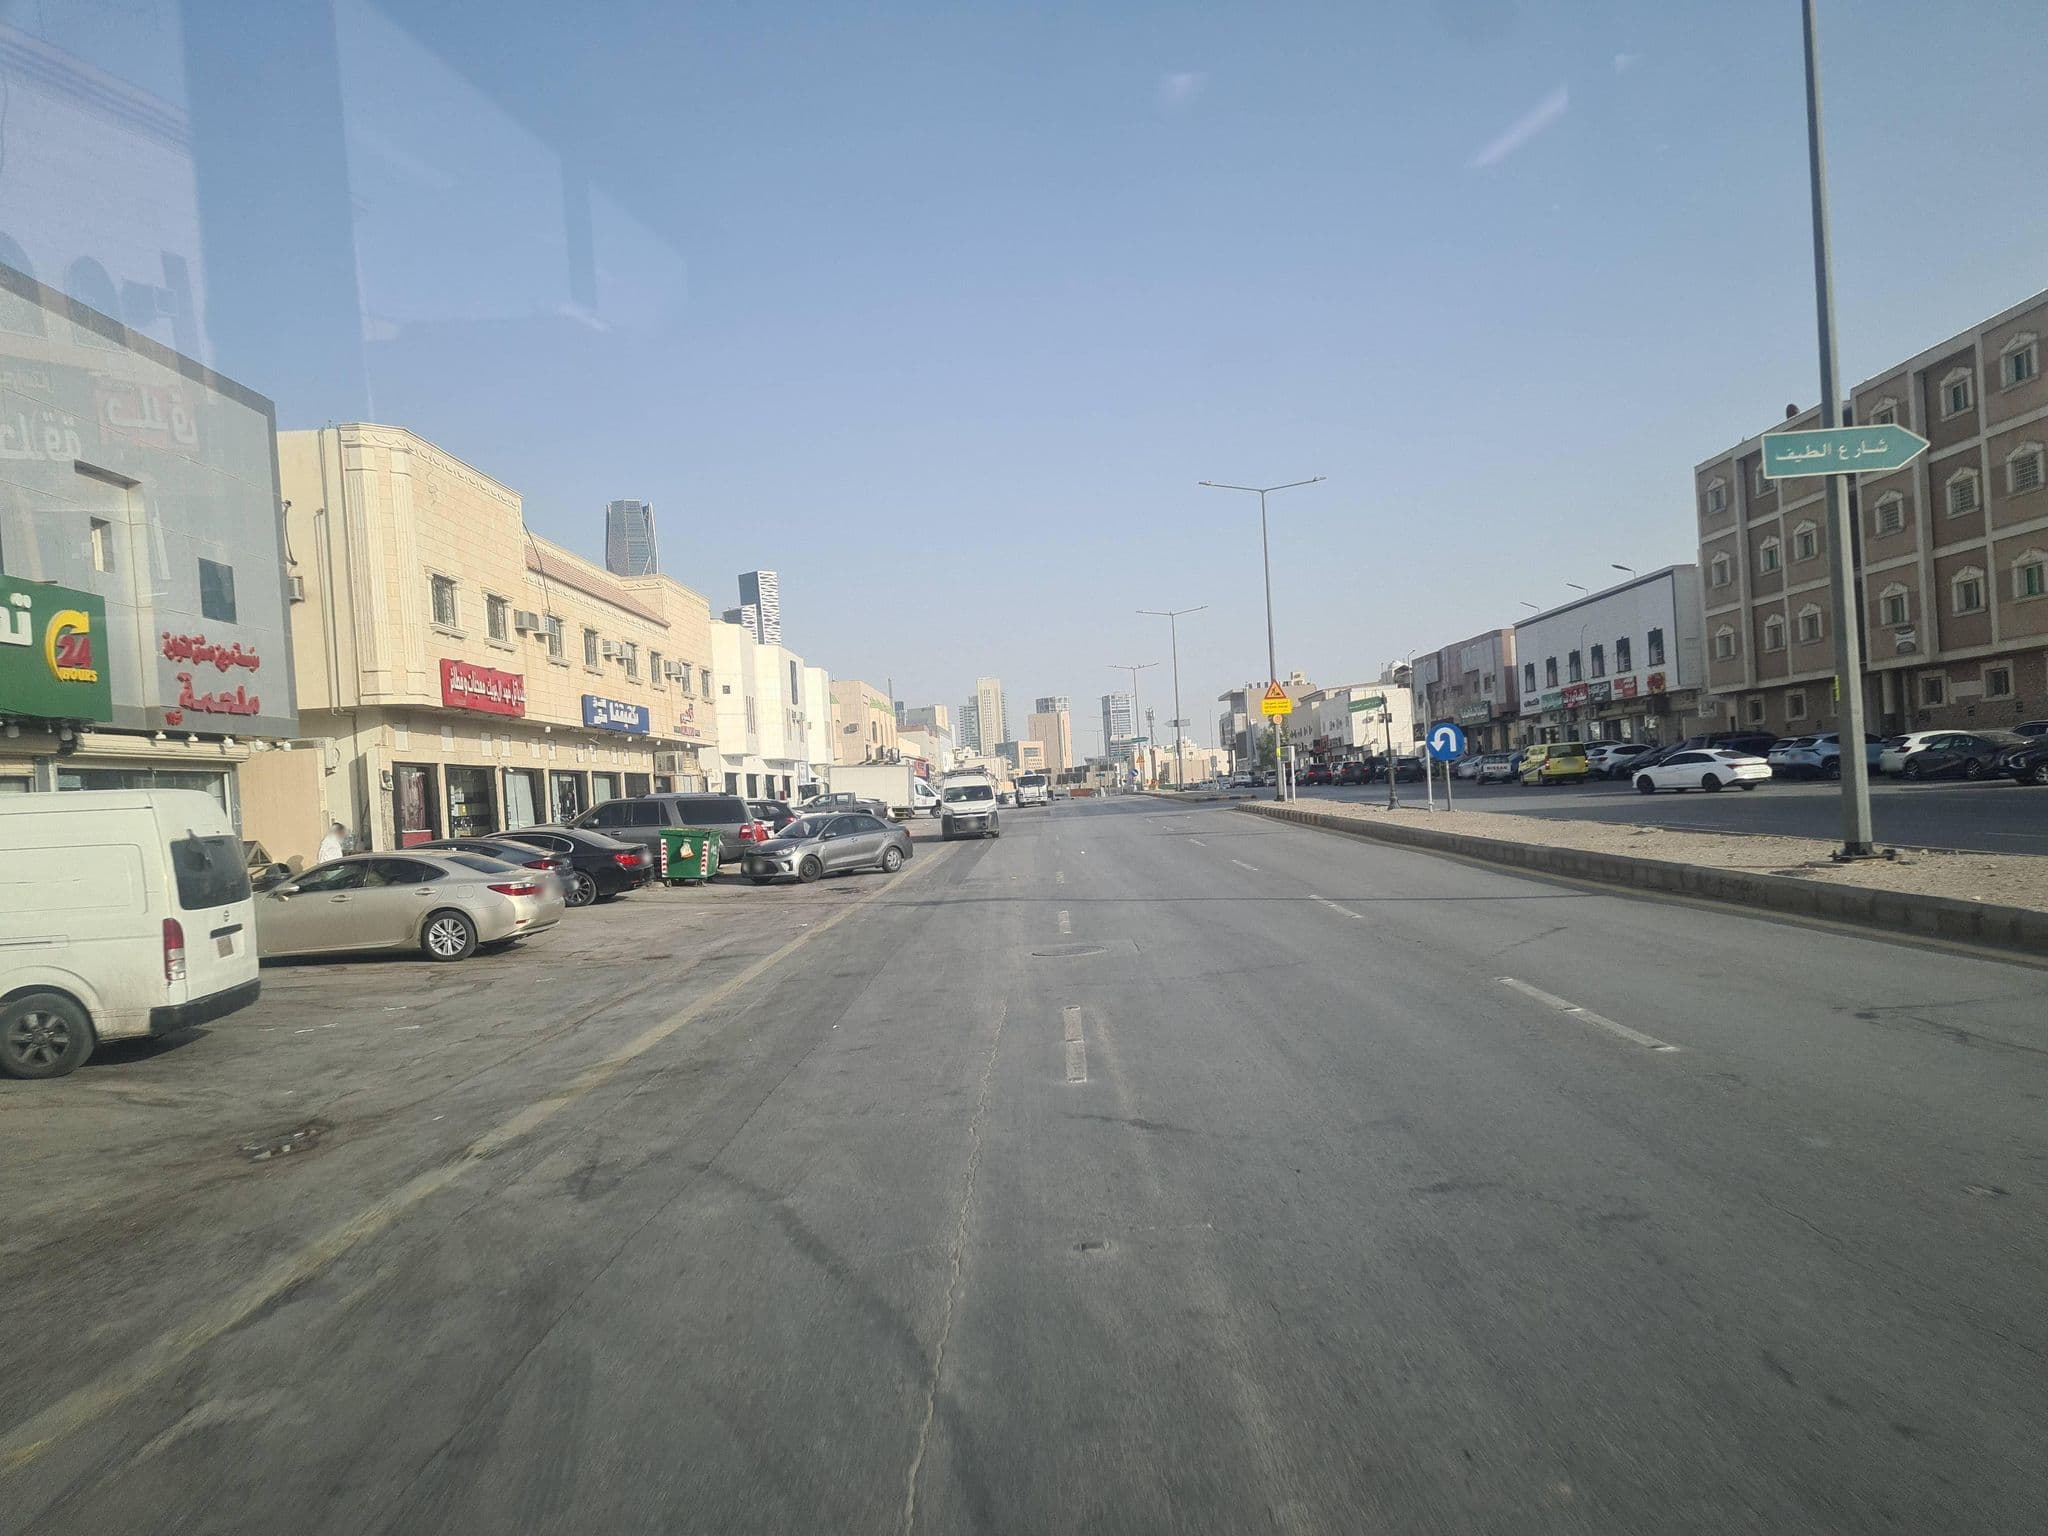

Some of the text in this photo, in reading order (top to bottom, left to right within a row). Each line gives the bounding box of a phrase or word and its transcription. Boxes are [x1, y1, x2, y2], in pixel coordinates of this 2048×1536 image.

[1838, 439, 1889, 460] شارع
[57, 634, 93, 669] 24
[177, 672, 260, 715] ملحمة
